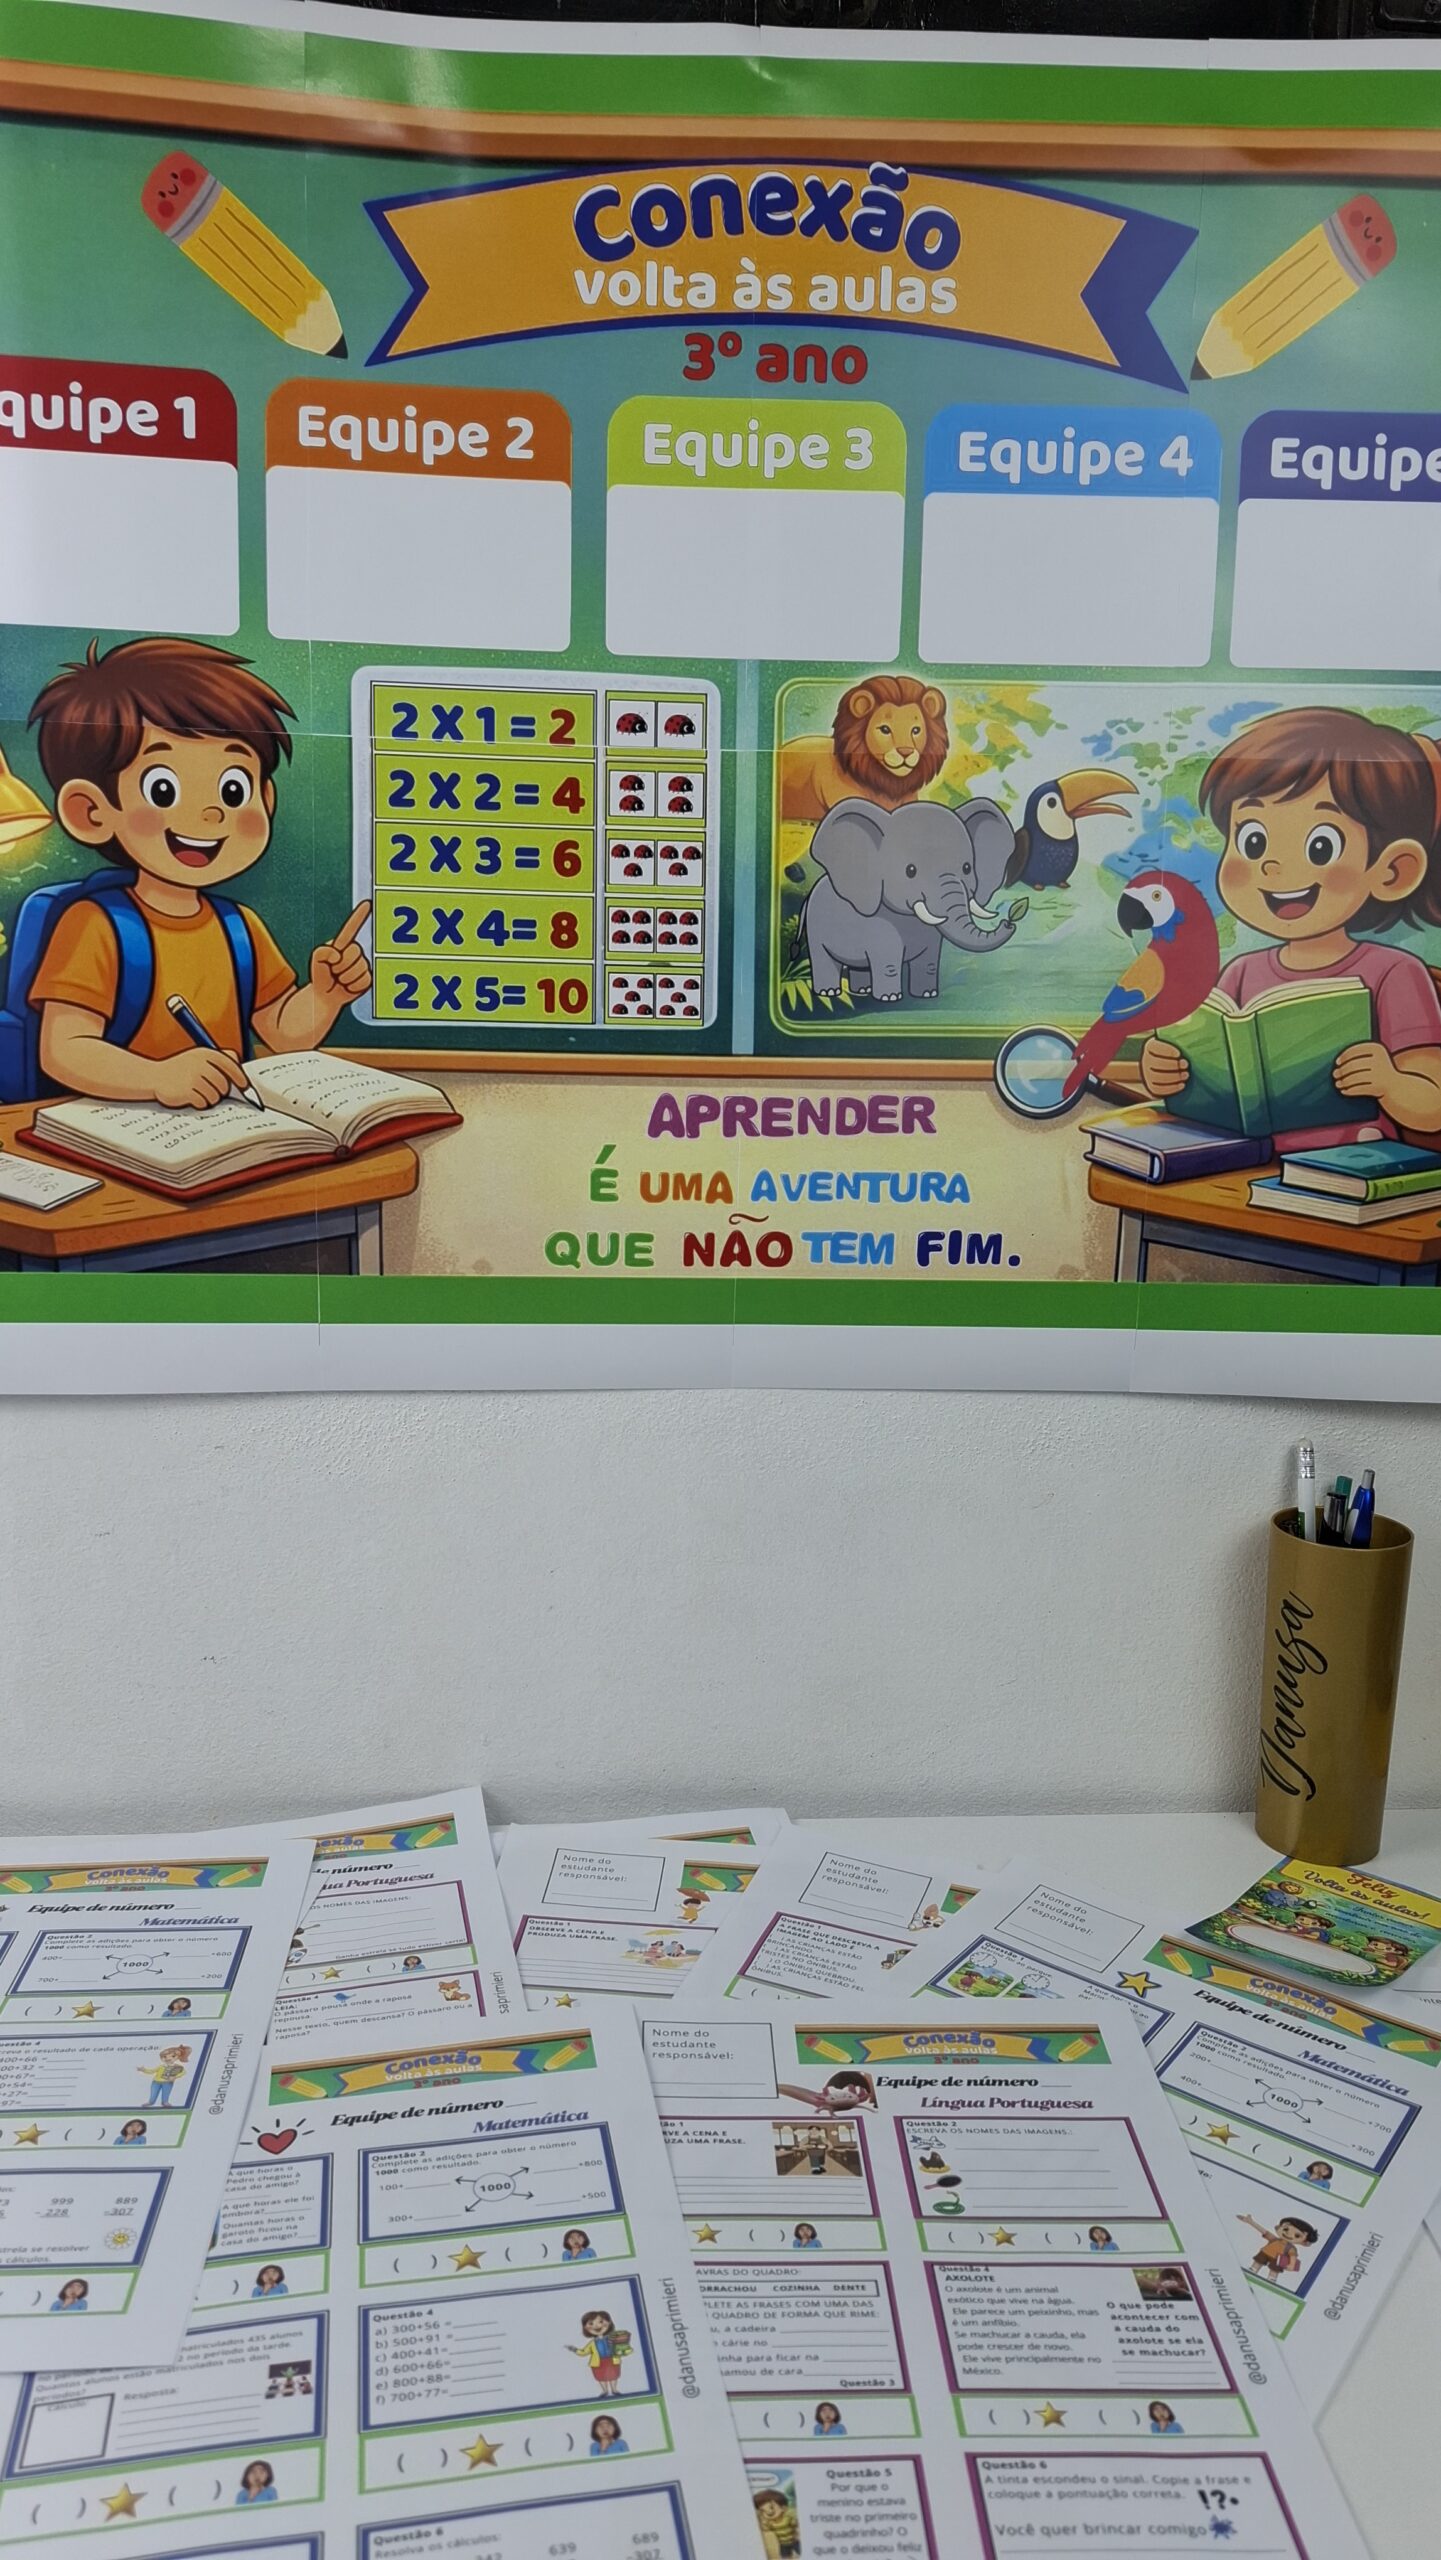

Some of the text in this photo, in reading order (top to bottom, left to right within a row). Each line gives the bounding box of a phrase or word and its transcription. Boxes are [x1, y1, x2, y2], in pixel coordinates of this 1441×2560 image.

[574, 161, 961, 271] Conexão
[573, 257, 958, 314] volta às aulas
[756, 343, 868, 385] ano
[0, 381, 196, 444] quipe 1
[298, 405, 534, 466] Equipe 2
[643, 419, 874, 479] Equipe 3
[958, 427, 1193, 487] Equipe 4
[391, 702, 419, 740] 2
[476, 706, 496, 744] 1
[548, 709, 576, 746] 2
[388, 770, 416, 807] 2
[474, 776, 501, 811] 2
[552, 777, 586, 814] 4
[388, 834, 417, 872] 2
[474, 836, 502, 874] 3
[552, 840, 582, 878] 6
[392, 906, 420, 944] 2
[550, 912, 579, 950] 8
[392, 974, 420, 1010] 2
[537, 978, 590, 1014] 10
[647, 1092, 937, 1138] APRENDER
[589, 1144, 971, 1204] É UMA AVENTURA
[544, 1212, 1021, 1269] QUE NÃO TEM FIM.
[331, 1862, 393, 1875] número
[561, 1863, 615, 1873] estudante
[563, 1855, 611, 1865] Nome do
[830, 1859, 878, 1876] Nome do
[87, 1866, 170, 1880] Conexão
[347, 1872, 434, 1888] Portuguesa
[558, 1871, 627, 1882] responsável:
[826, 1867, 879, 1884] estudante
[821, 1875, 889, 1895] responsável:
[1347, 1872, 1400, 1899] Feliz
[1040, 1892, 1087, 1914] Nome do
[1304, 1870, 1431, 1919] Volta às aulas!
[27, 1903, 175, 1914] Equipe de número
[1034, 1899, 1086, 1923] estudante
[139, 1915, 239, 1926] Matemática
[1026, 1905, 1095, 1935] responsável:
[1250, 1978, 1337, 2015] Conexão
[1194, 1989, 1348, 2051] Equipe de número
[652, 2029, 710, 2037] Nome do
[903, 2031, 996, 2048] Conexão
[652, 2040, 716, 2049] estudante
[905, 2046, 939, 2054] volta
[961, 2046, 998, 2054] aulas
[385, 2050, 481, 2073] Conexão
[652, 2050, 734, 2060] responsável:
[386, 2070, 422, 2081] volta
[444, 2064, 482, 2075] aulas
[1298, 2050, 1410, 2097] Matemática
[433, 2077, 461, 2086] ano
[877, 2076, 1038, 2089] Equipe de número
[921, 2097, 1094, 2111] Língua Portuguesa
[1270, 2093, 1298, 2109] 1000
[331, 2100, 503, 2127] Equipe de número
[473, 2110, 589, 2133] Matemática
[479, 2182, 511, 2193] 1000
[945, 2274, 995, 2282] AXOLOTE
[773, 2284, 820, 2292] COZINHA
[1107, 2301, 1174, 2311] O que pode
[373, 2310, 423, 2323] Questão
[375, 2327, 388, 2336] a)
[658, 2276, 701, 2399] @danusaprimieri
[375, 2340, 388, 2349] b)
[1139, 2348, 1206, 2357] machucar?
[375, 2353, 387, 2363] c)
[375, 2367, 389, 2376] d)
[375, 2380, 388, 2390] e)
[826, 2468, 893, 2479] Questão 5
[981, 2460, 1047, 2471] Questão 6
[994, 2523, 1207, 2538] Você quer brincar comigo
